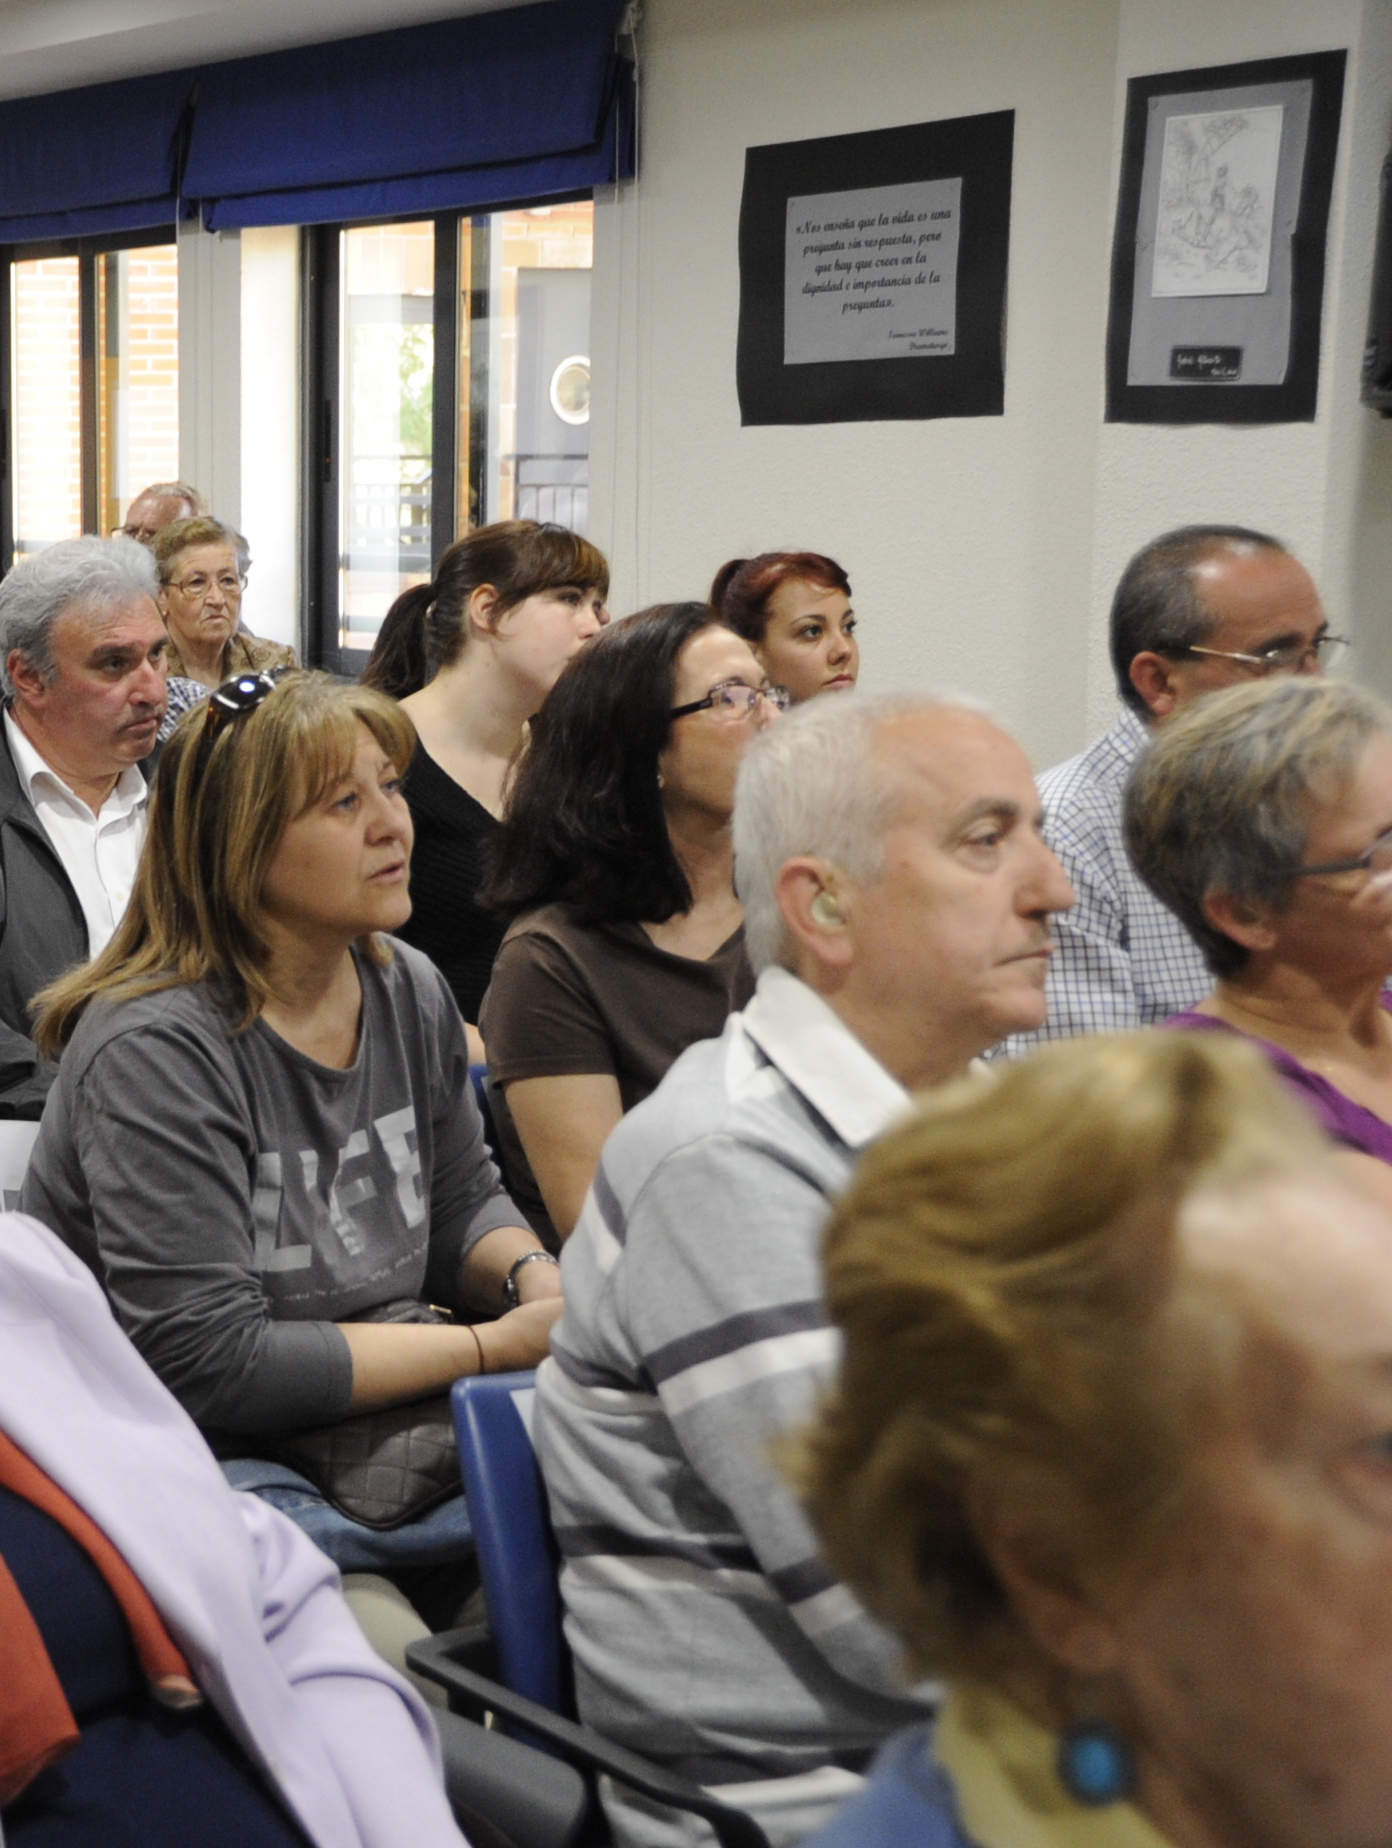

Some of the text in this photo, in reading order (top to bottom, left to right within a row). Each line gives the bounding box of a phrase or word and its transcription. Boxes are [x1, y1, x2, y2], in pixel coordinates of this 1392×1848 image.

[823, 218, 855, 232] enseña
[858, 218, 875, 231] que
[877, 213, 889, 226] la
[892, 210, 915, 224] vida
[917, 213, 928, 221] es
[930, 209, 952, 220] una
[803, 232, 942, 258] pregunta sin respuesta, pero
[814, 251, 927, 276] que hay que creer en la
[802, 270, 940, 297] dignidad e importancia de la
